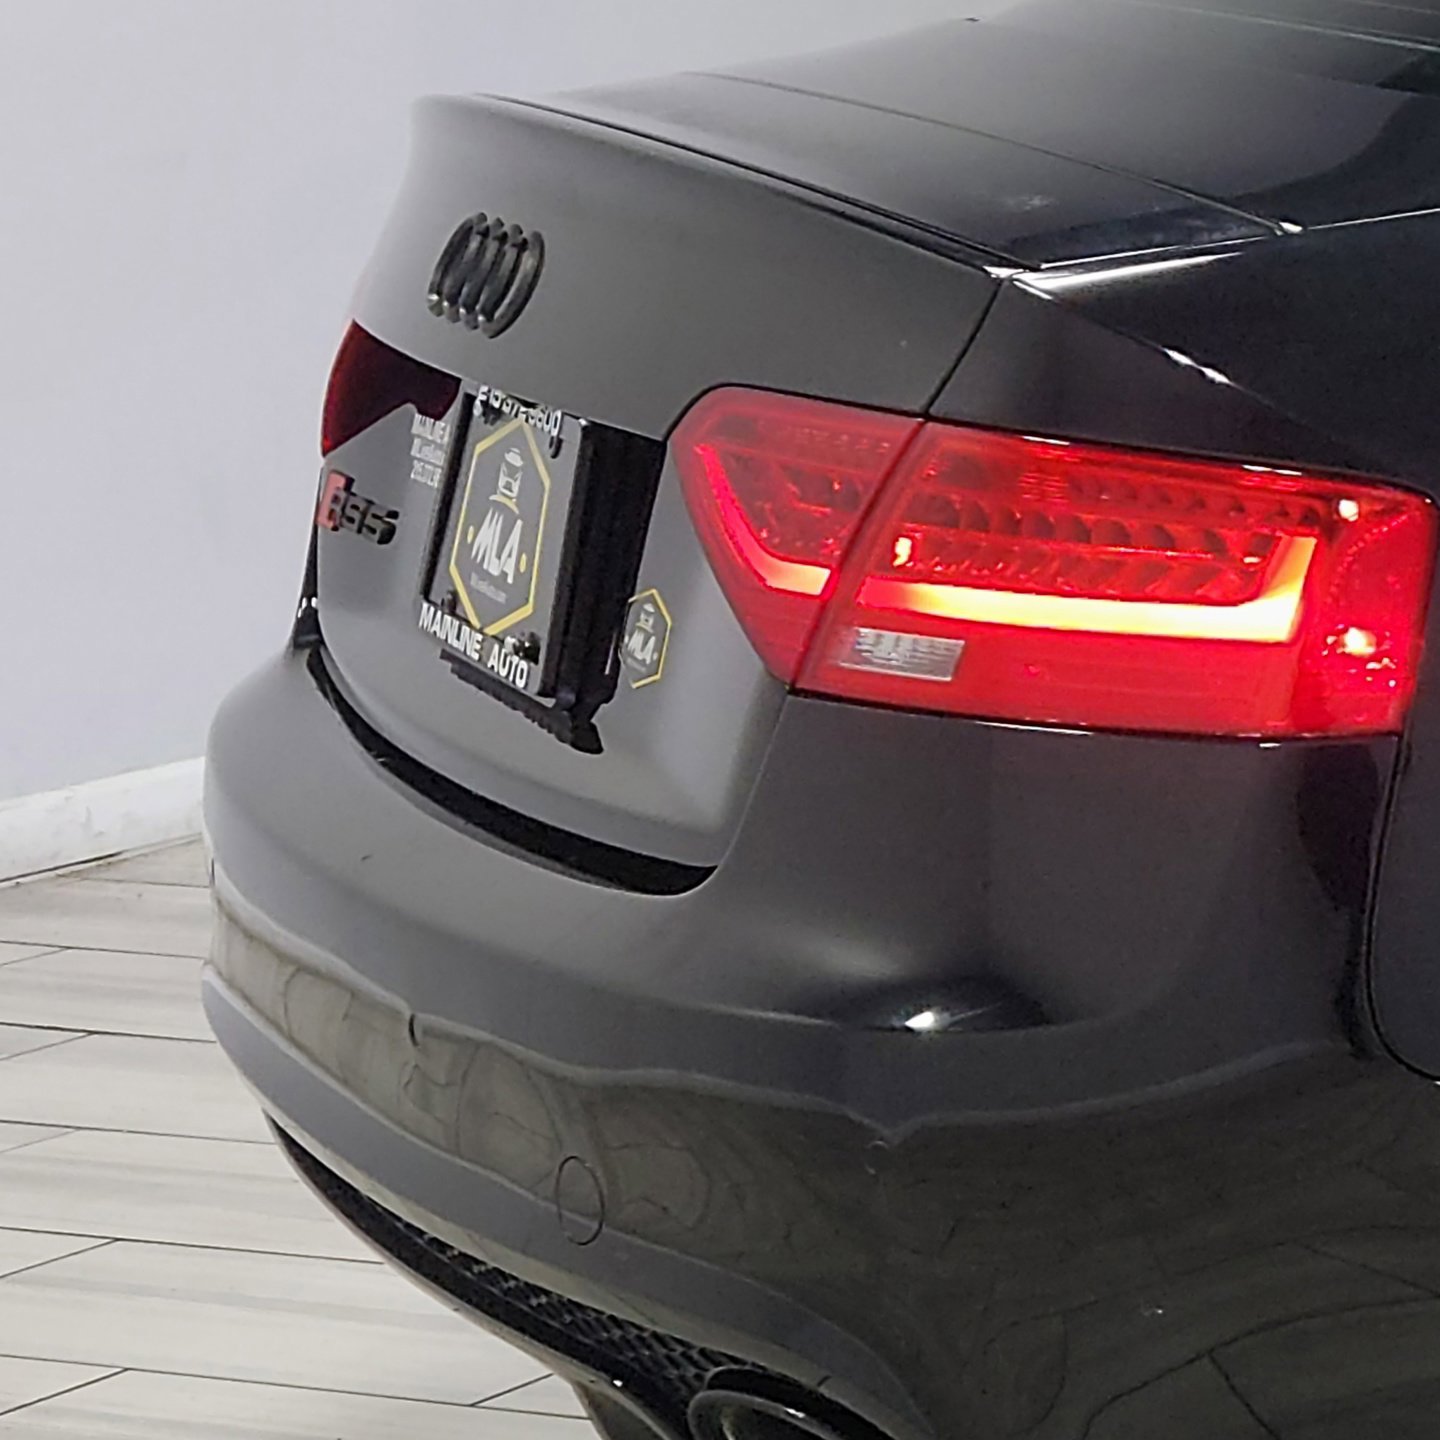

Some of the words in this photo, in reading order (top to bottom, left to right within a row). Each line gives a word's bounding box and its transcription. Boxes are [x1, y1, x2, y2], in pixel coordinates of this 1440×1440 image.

[471, 507, 523, 585] MLA
[418, 601, 484, 661] MAINLINE
[487, 643, 529, 688] AUTO
